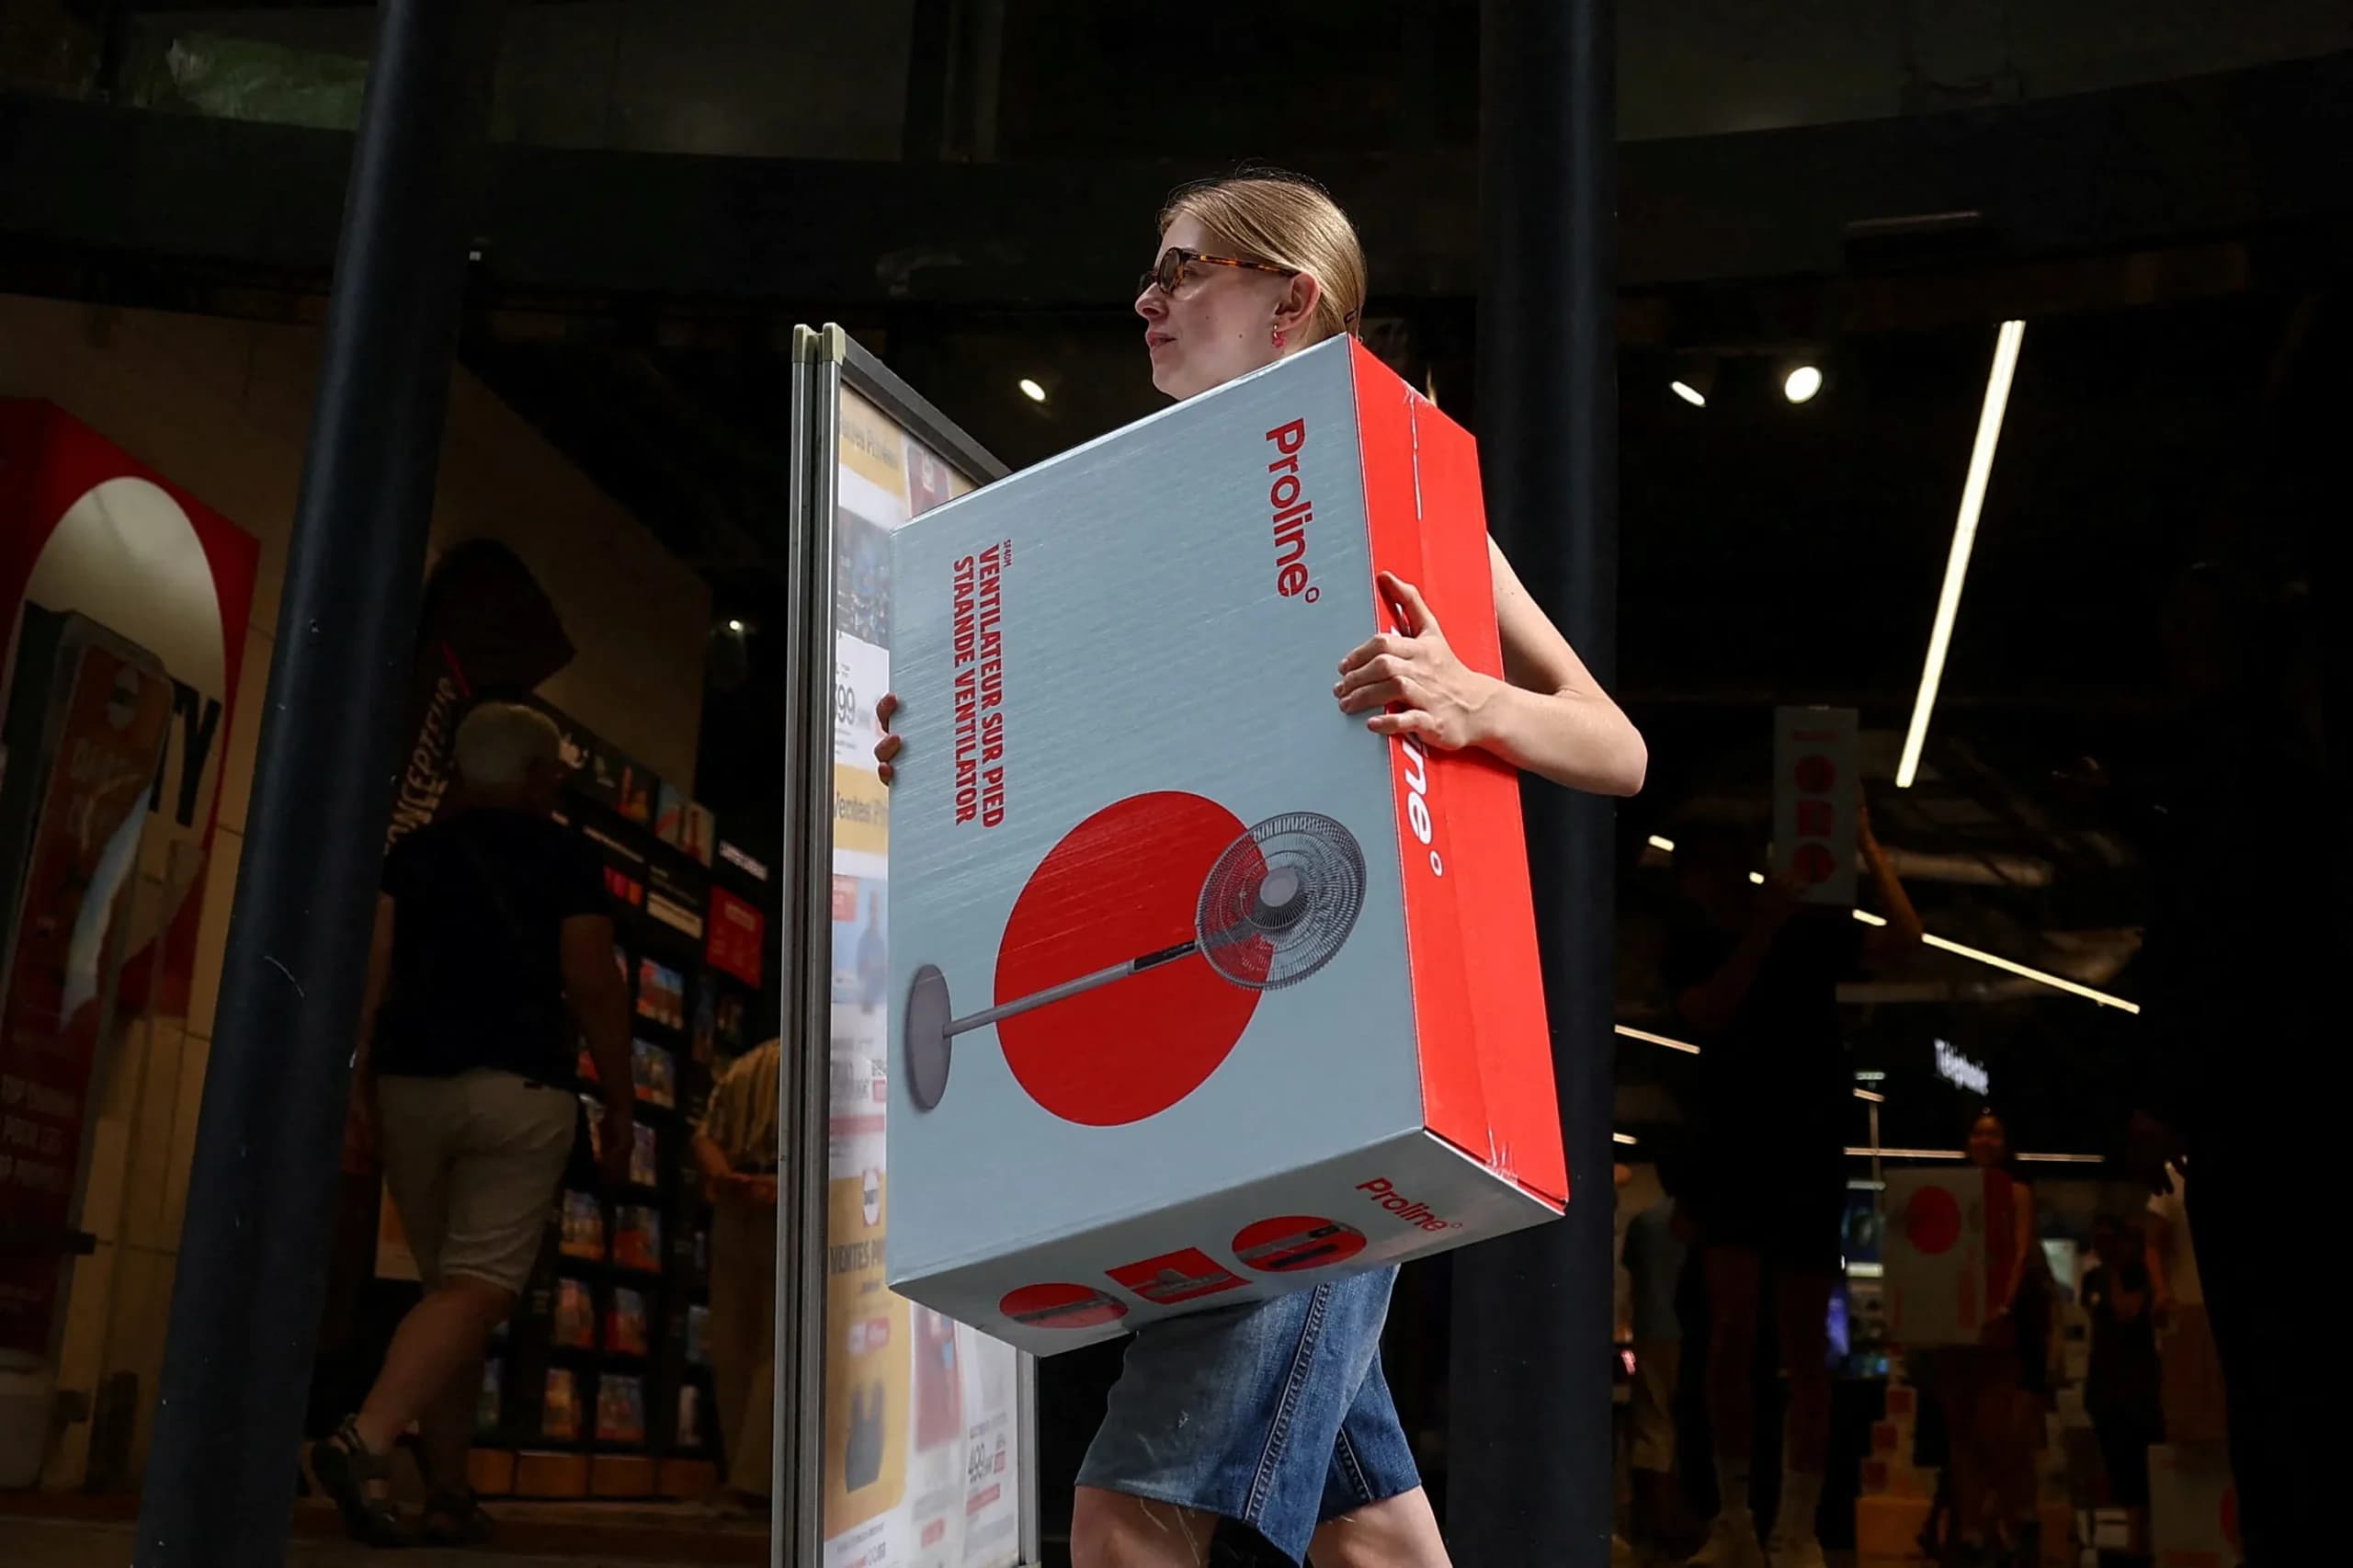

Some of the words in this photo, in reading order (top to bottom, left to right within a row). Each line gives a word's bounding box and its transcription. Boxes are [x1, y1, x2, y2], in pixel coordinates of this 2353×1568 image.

[953, 555, 975, 668] STAANDE
[979, 544, 1002, 709] VENTILATEUR
[955, 668, 977, 825] VENTILATOR
[982, 712, 1004, 765] SUR
[983, 766, 1005, 828] PIED
[1355, 1177, 1448, 1231] Proline
